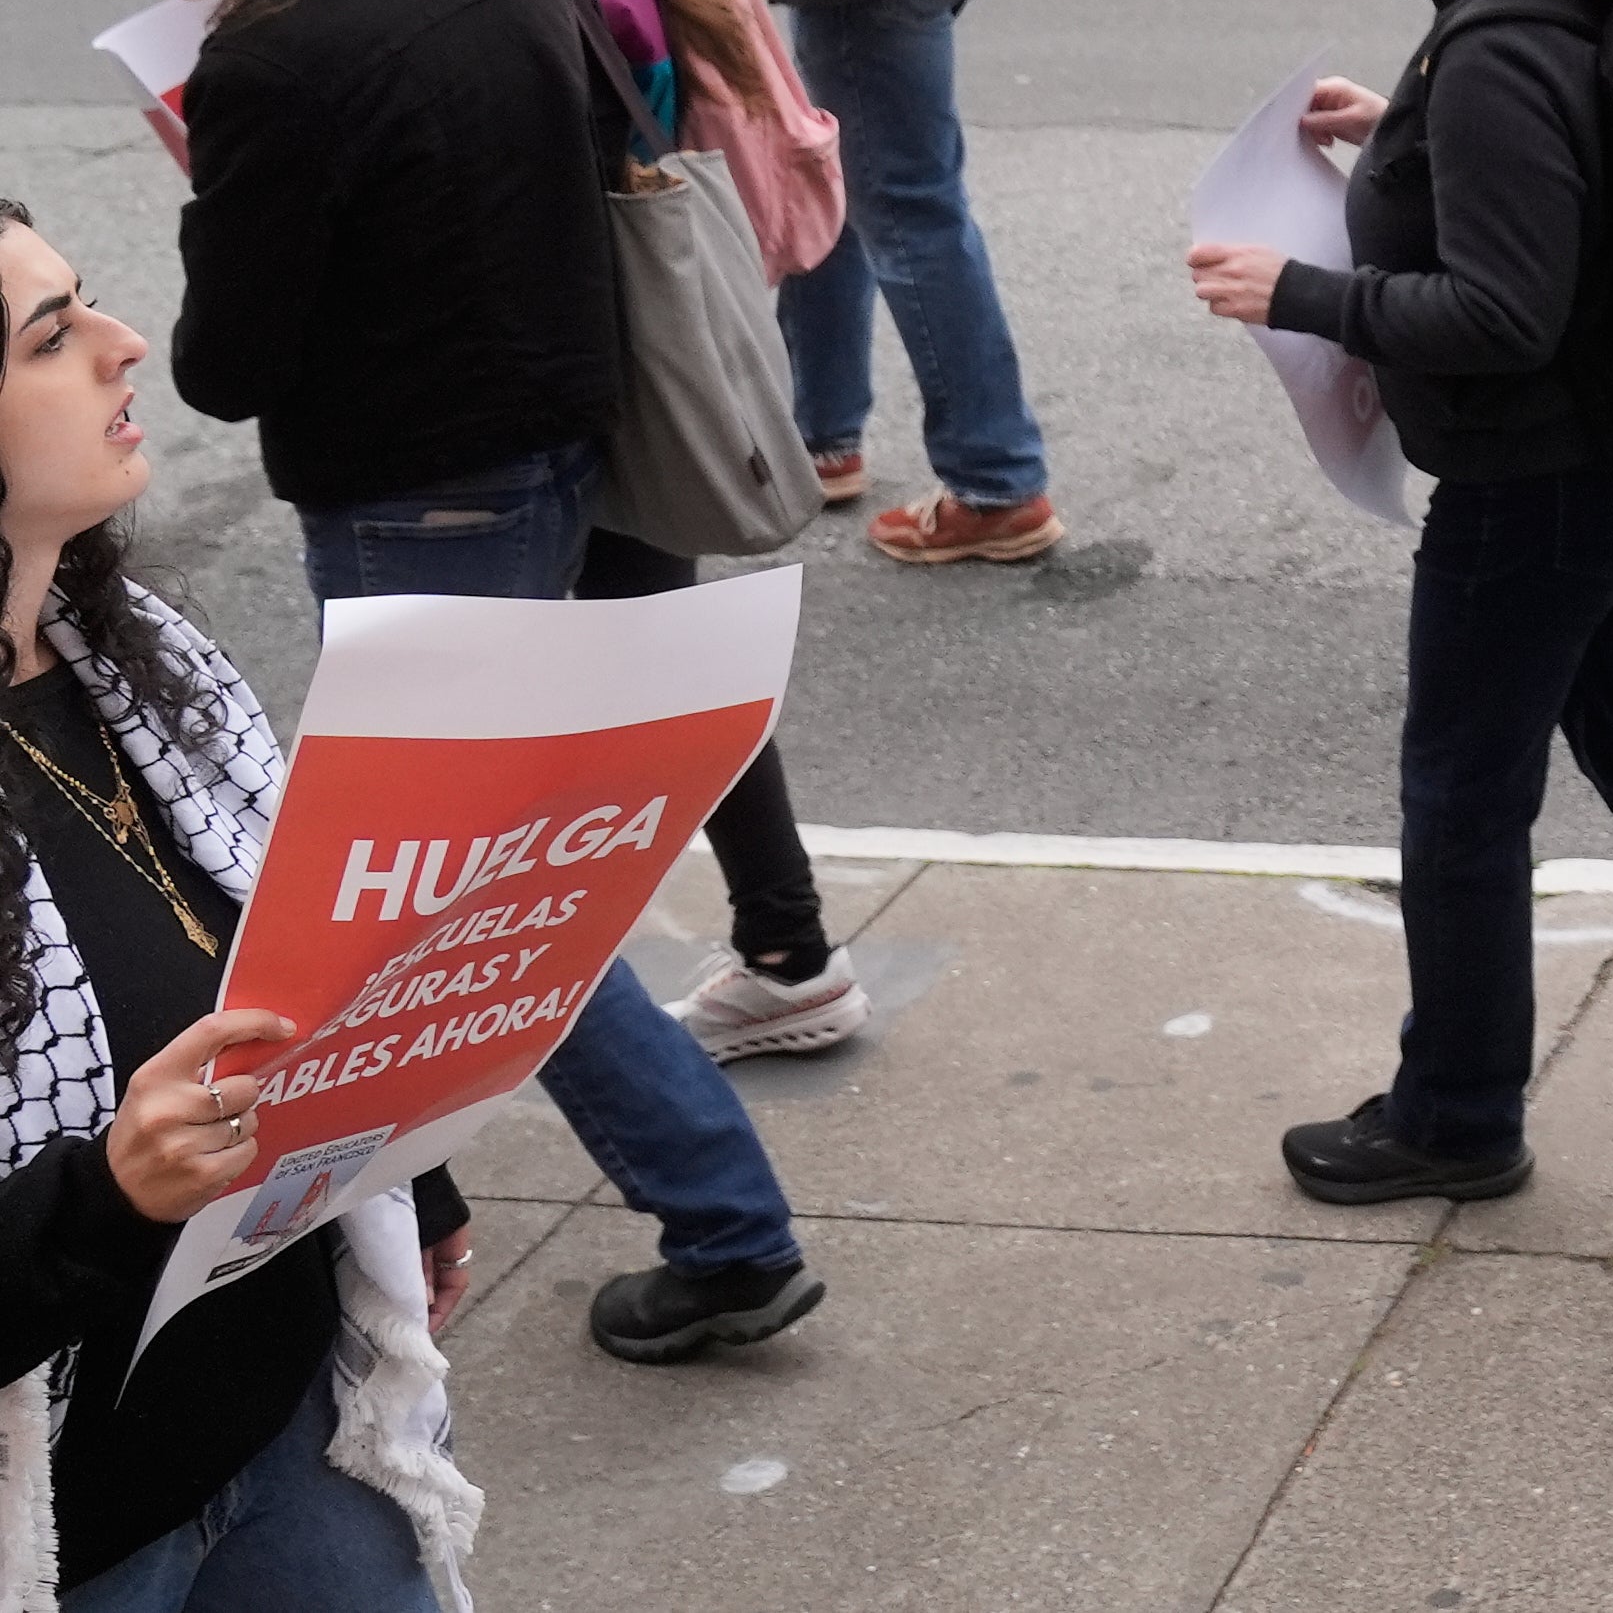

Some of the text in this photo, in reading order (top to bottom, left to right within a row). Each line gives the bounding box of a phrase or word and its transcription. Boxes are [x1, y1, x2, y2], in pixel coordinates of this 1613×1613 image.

[330, 794, 669, 922] HUELGA
[510, 943, 553, 983] Y
[396, 980, 582, 1068] AHORA!
[291, 1161, 317, 1176] SAN
